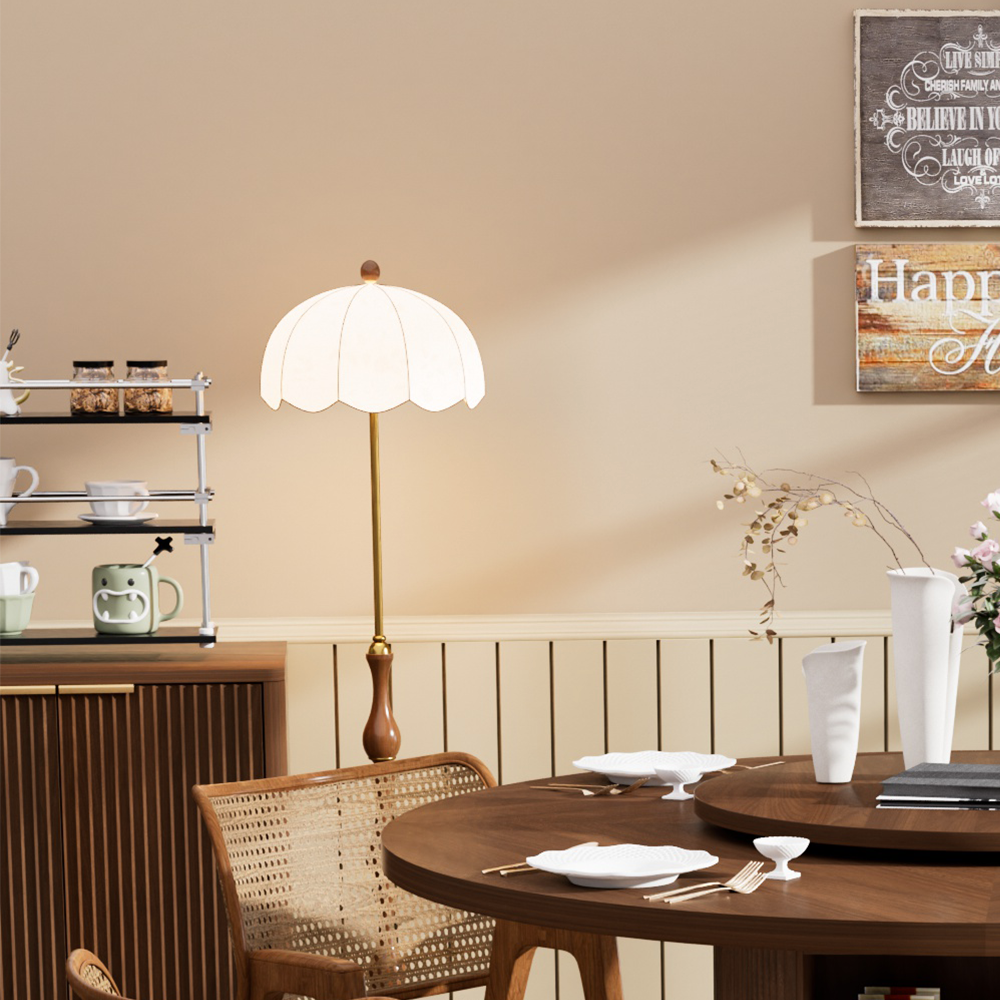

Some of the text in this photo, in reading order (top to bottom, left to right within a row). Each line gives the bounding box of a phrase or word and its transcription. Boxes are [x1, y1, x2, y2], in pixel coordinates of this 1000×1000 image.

[945, 51, 972, 69] LIVE
[924, 79, 960, 92] CHERISH
[960, 79, 989, 91] FAMILY
[906, 106, 967, 131] BELIEVE
[969, 106, 985, 130] IN
[942, 148, 981, 167] LAUGH
[953, 175, 982, 186] LOVE
